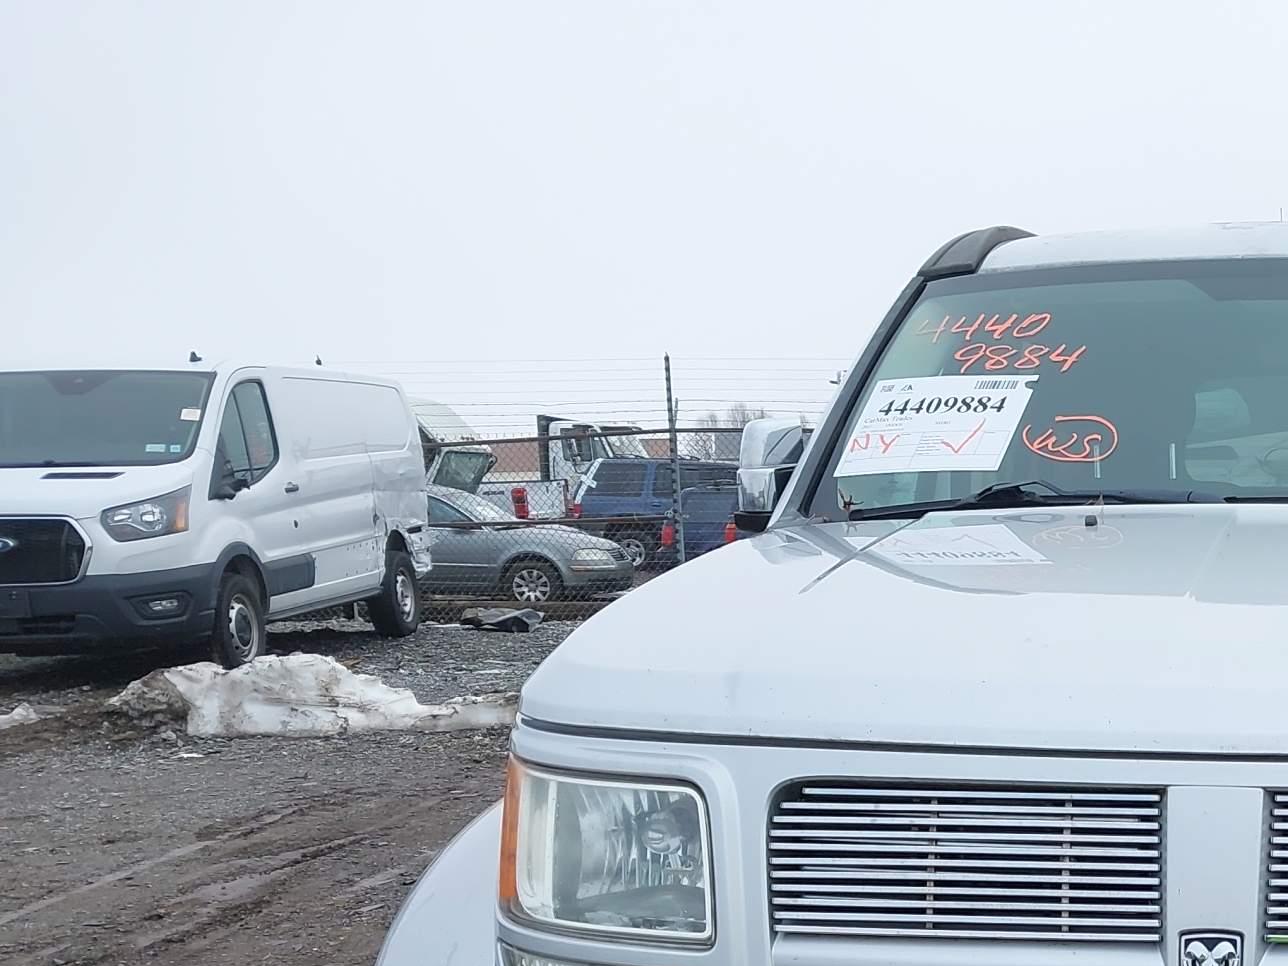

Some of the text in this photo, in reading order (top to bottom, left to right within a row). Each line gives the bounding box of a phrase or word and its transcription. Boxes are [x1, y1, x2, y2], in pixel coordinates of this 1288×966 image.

[914, 312, 1052, 344] 4440
[953, 342, 1088, 374] 9884
[878, 395, 1008, 416] 44409884
